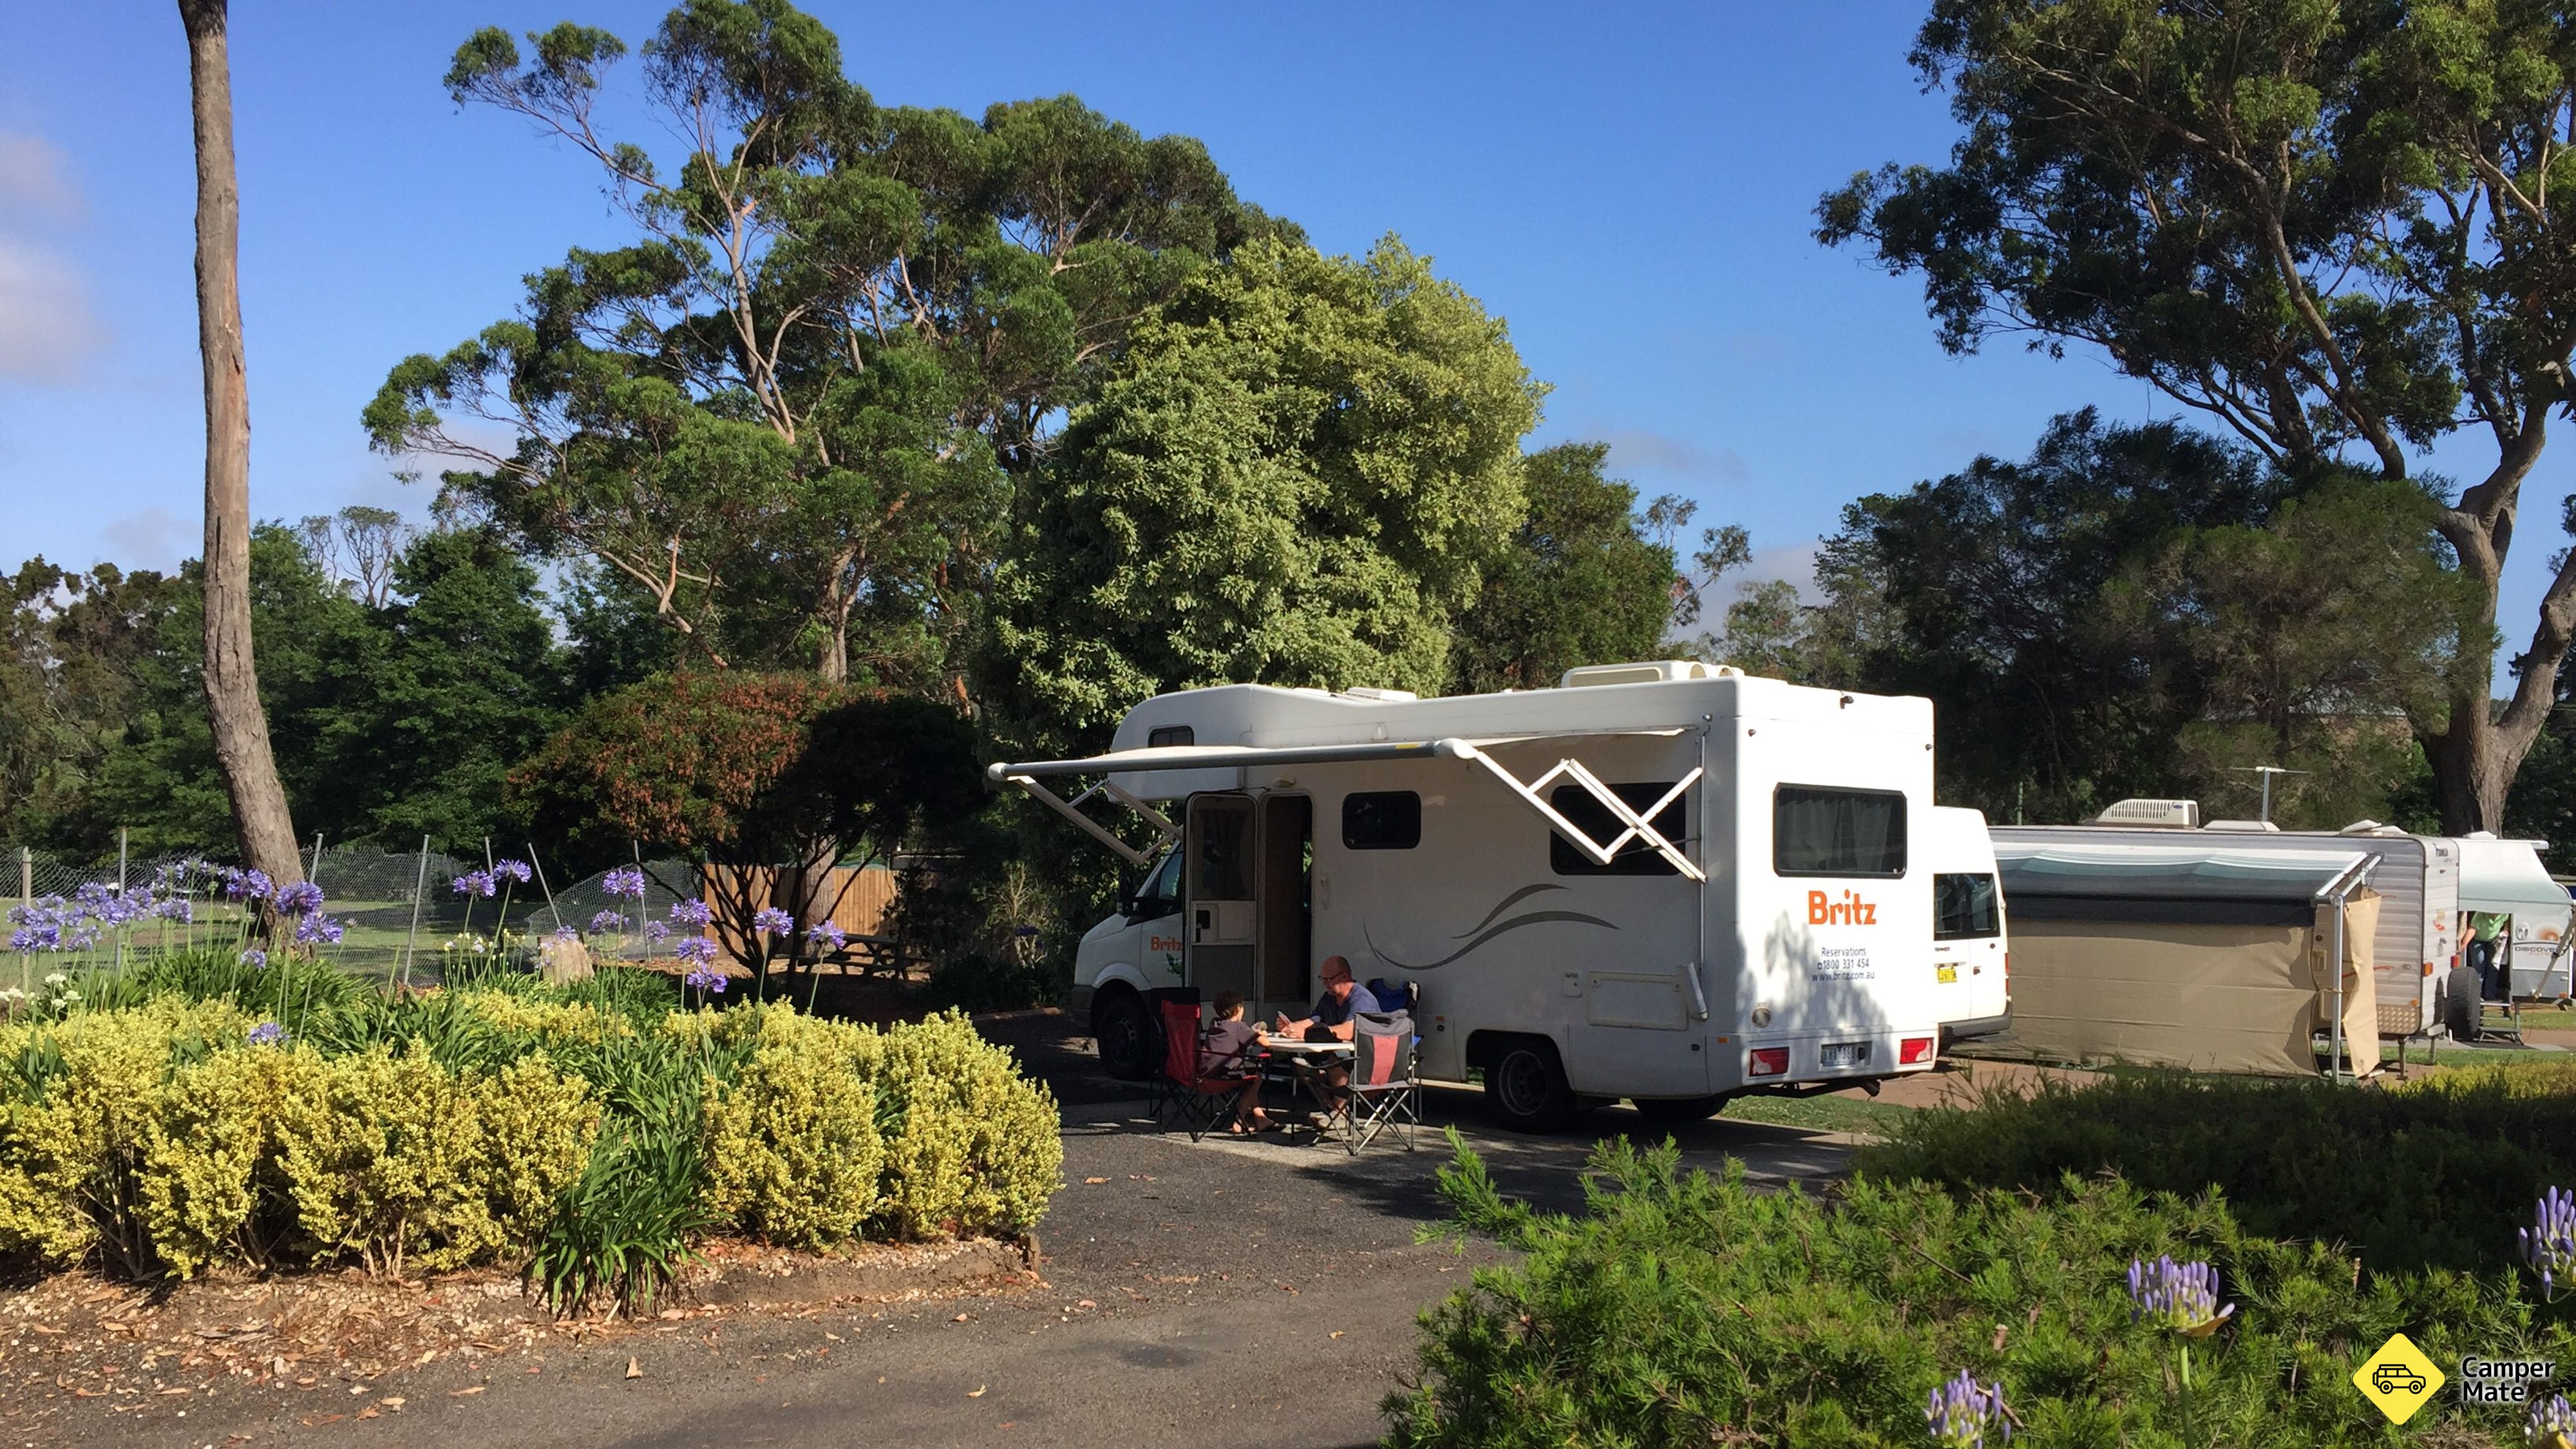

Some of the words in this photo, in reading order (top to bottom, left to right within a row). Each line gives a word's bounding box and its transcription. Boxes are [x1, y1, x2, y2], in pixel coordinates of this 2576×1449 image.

[1808, 889, 1877, 925] Britz
[1150, 936, 1183, 951] Britz
[1821, 947, 1867, 958] Reservations
[1823, 959, 1840, 970] 1800
[1842, 958, 1854, 969] 331
[1857, 958, 1870, 969] 454
[1811, 971, 1875, 981] www.britz.com.au
